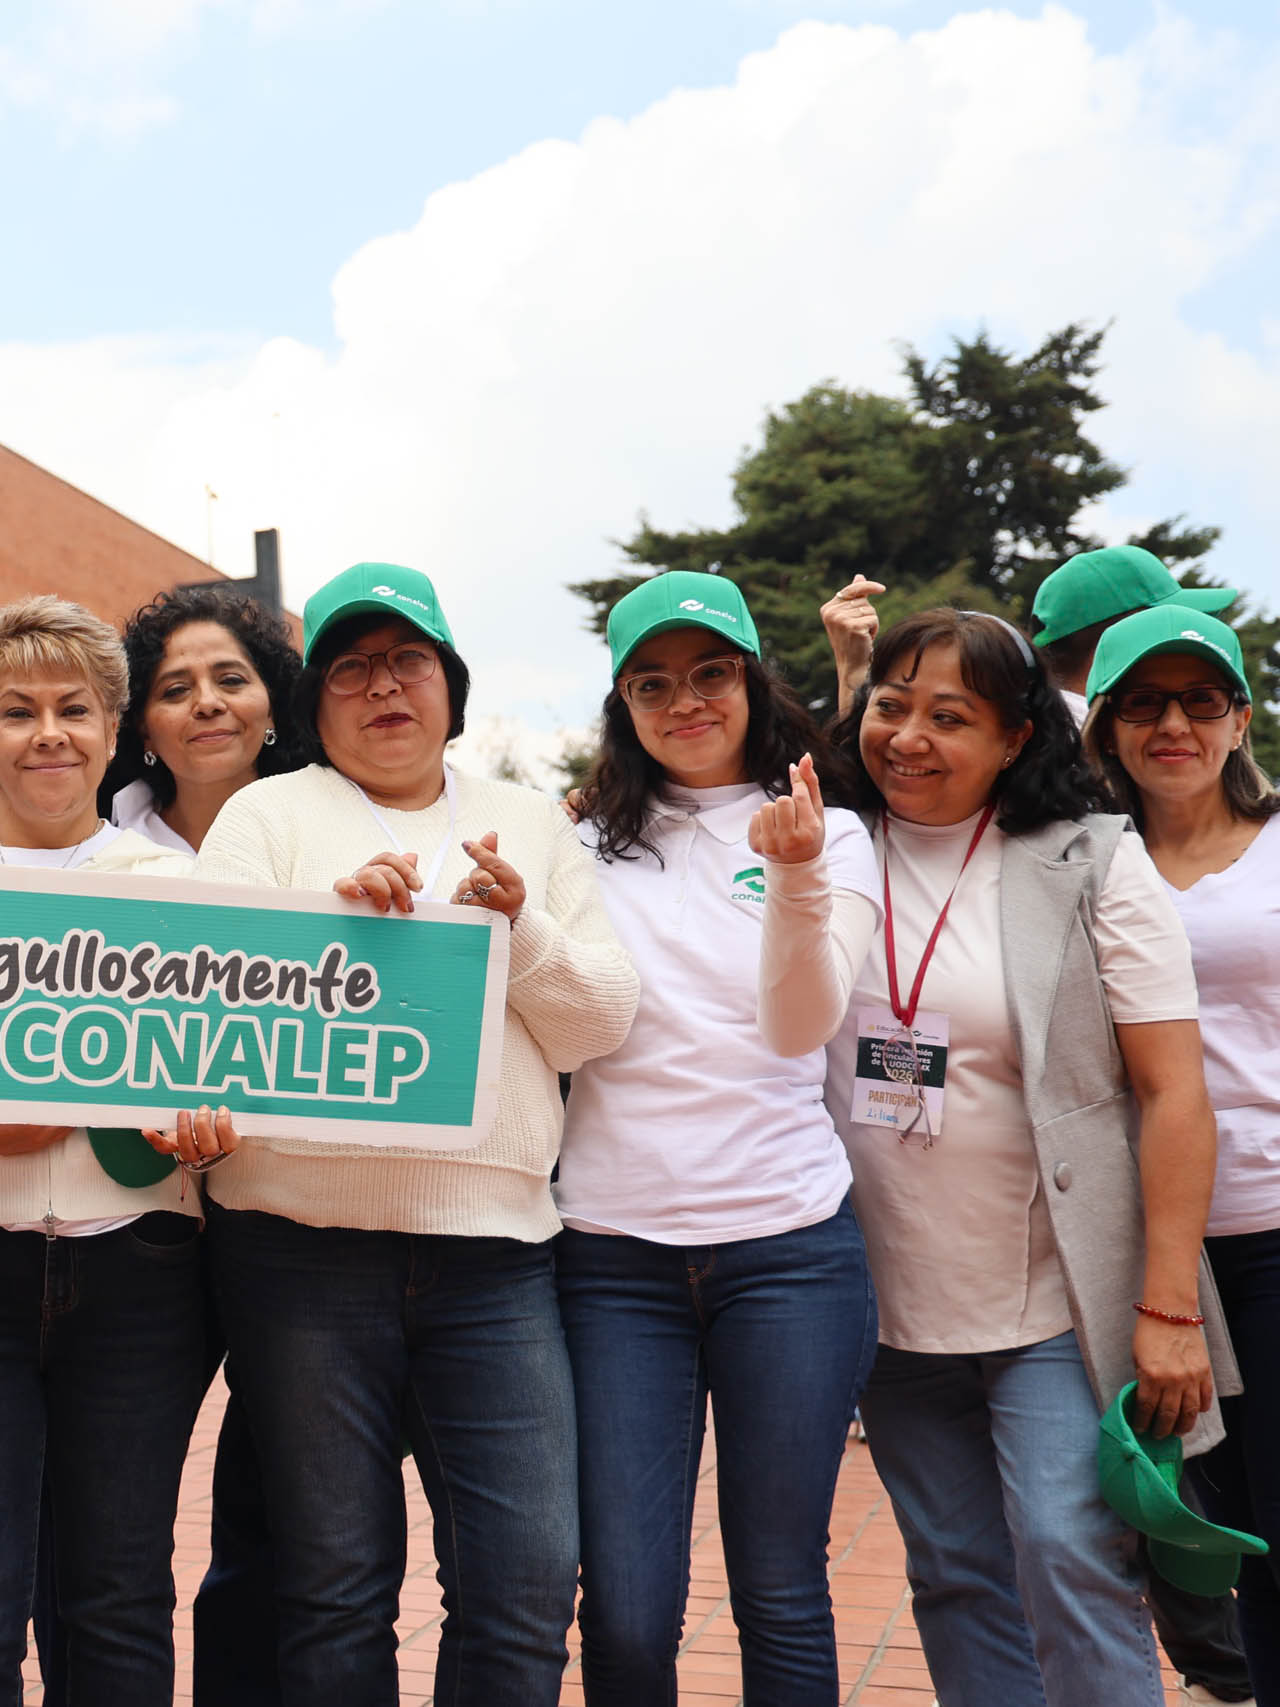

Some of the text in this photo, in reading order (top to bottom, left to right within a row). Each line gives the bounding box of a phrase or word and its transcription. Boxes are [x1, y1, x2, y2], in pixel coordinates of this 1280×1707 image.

[731, 893, 765, 904] conal
[0, 1002, 429, 1104] CONALEP
[871, 1043, 899, 1053] Priera
[868, 1090, 926, 1107] PARTICIPAN
